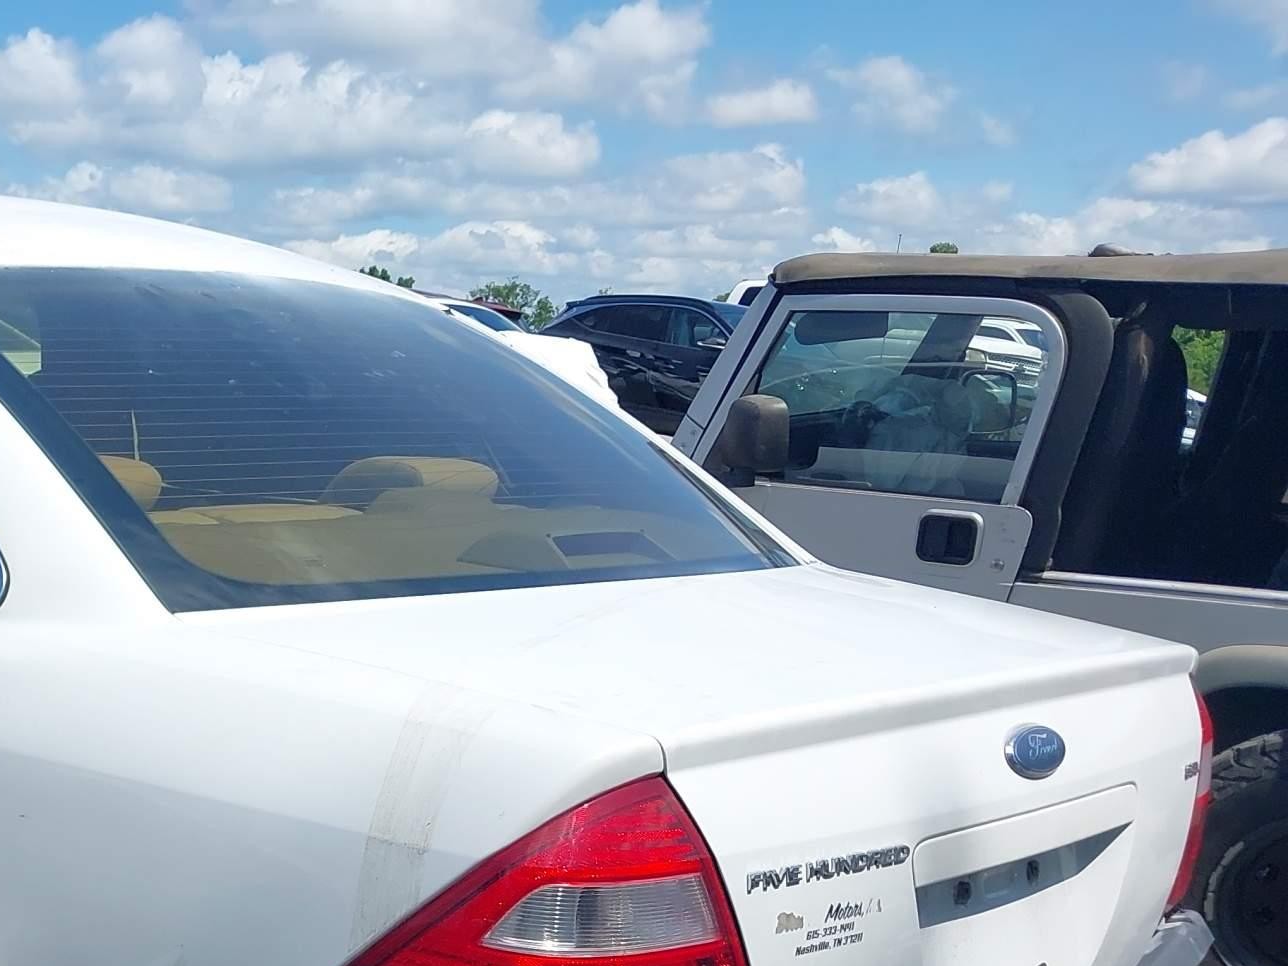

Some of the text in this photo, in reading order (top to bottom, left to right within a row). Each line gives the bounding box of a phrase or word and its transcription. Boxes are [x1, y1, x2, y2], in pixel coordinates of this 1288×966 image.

[1027, 733, 1058, 761] Ford
[746, 845, 910, 895] FIVE HUNDRED
[833, 936, 844, 949] TN
